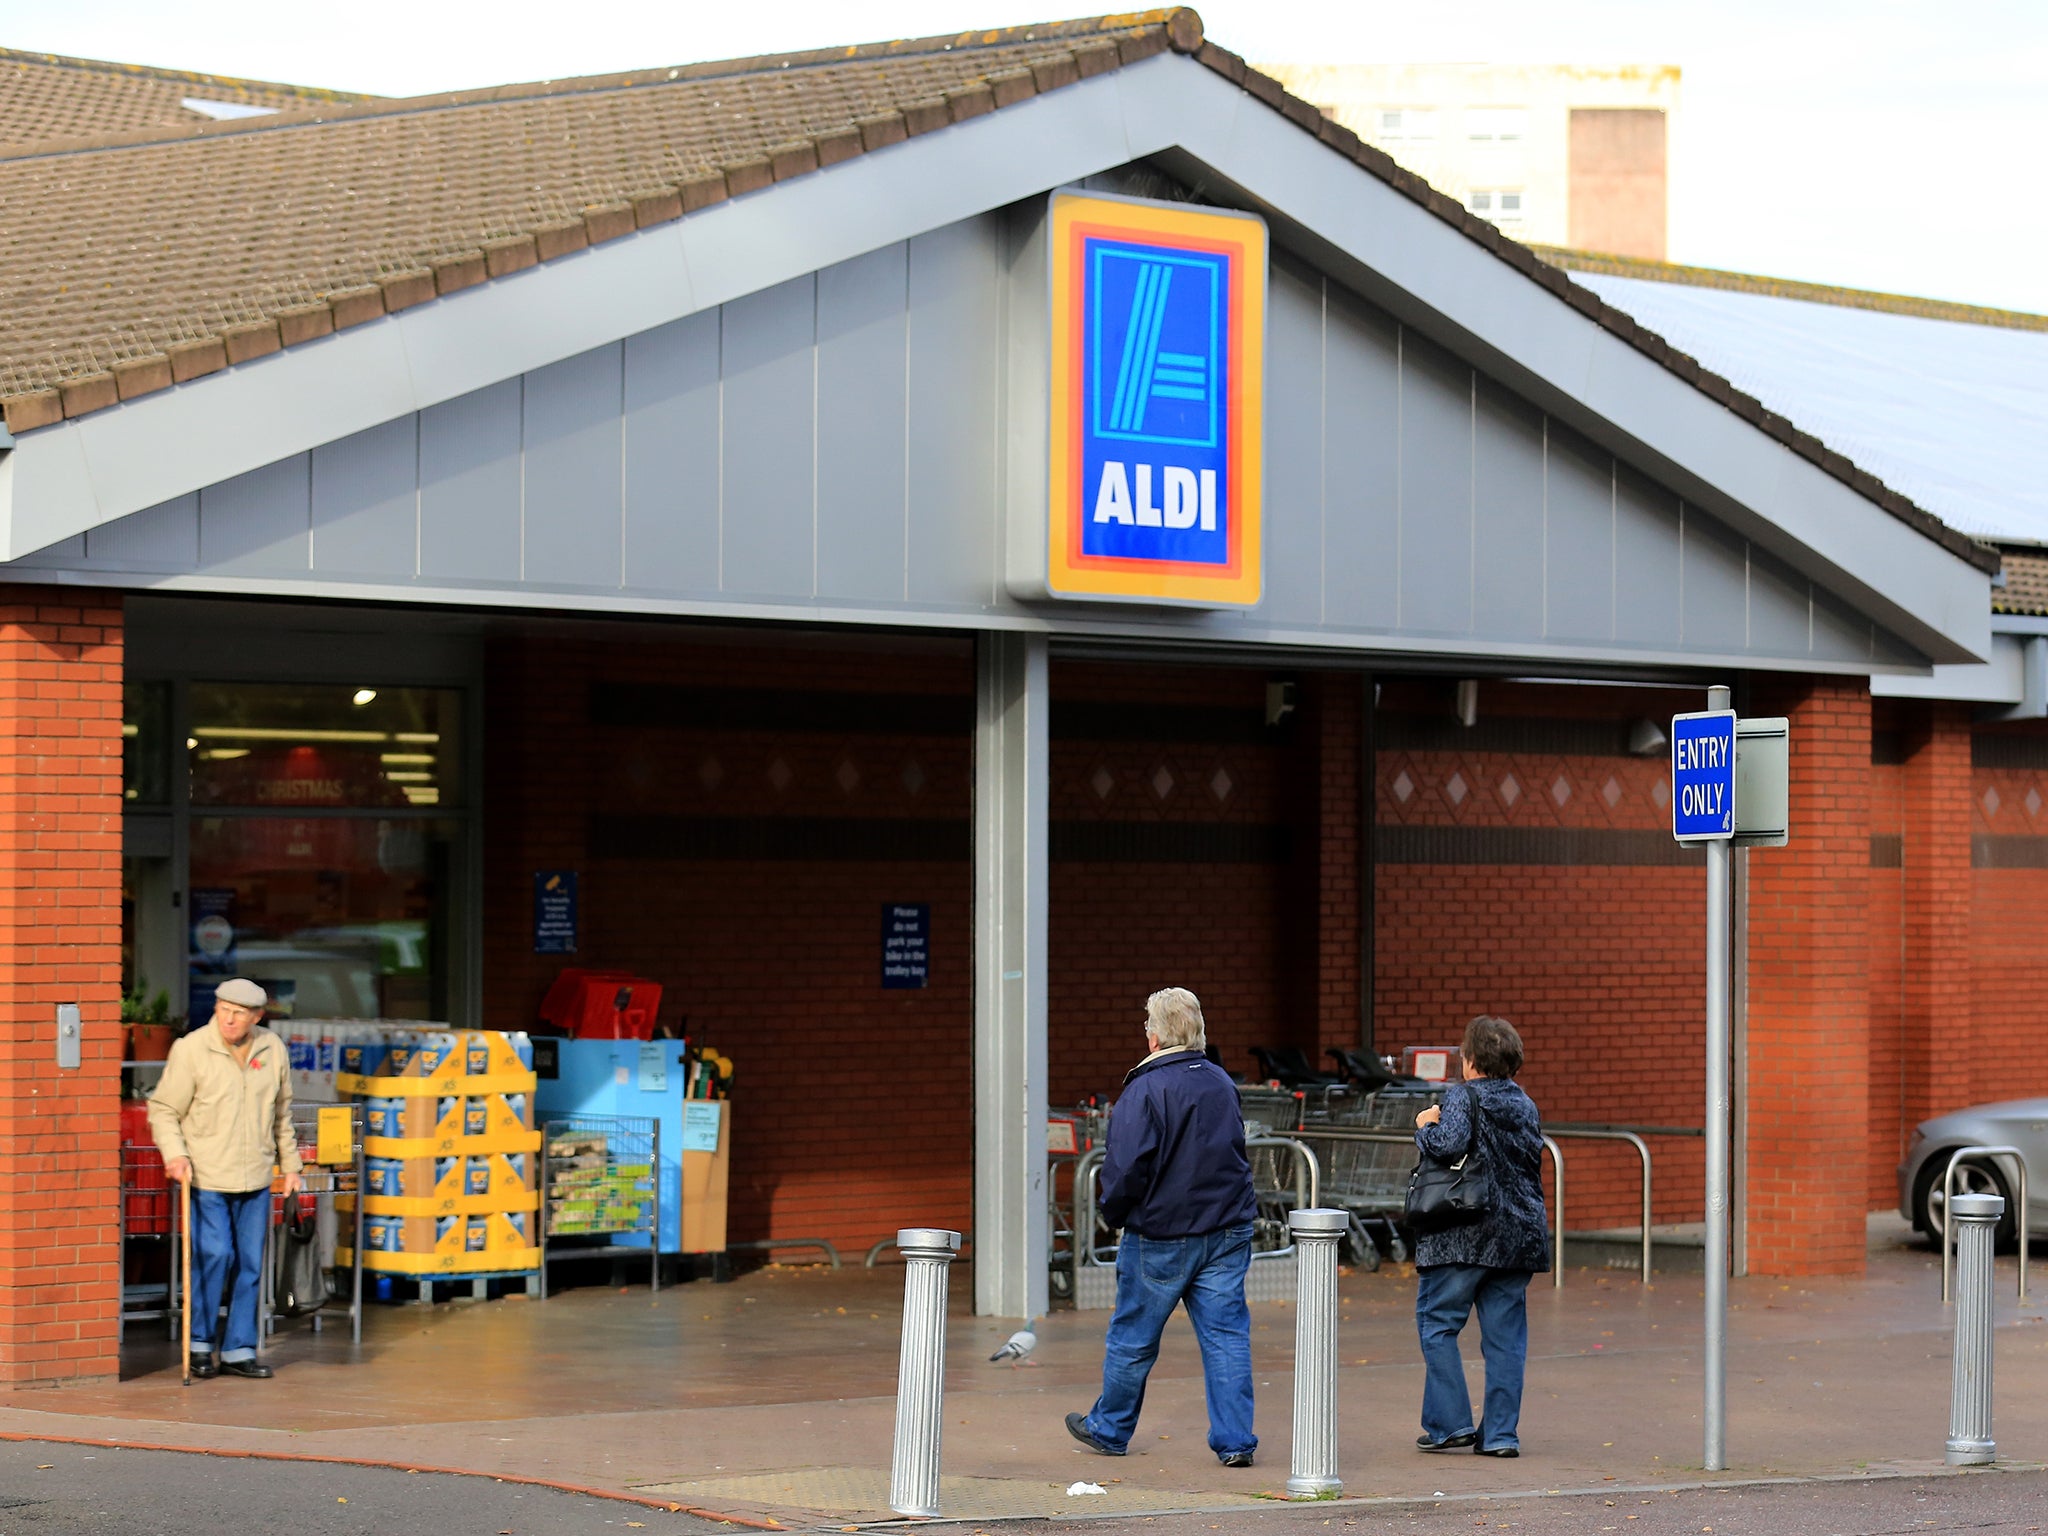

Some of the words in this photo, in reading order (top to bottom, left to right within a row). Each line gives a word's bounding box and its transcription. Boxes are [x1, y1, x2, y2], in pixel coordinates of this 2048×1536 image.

[1093, 460, 1217, 532] ALDI
[1677, 735, 1729, 771] ENTRY
[256, 779, 343, 799] CHRISTMAS
[1681, 782, 1724, 817] ONLY
[893, 906, 919, 917] Please
[893, 922, 903, 932] do
[905, 922, 919, 932] not
[886, 936, 905, 949] park
[906, 937, 924, 949] your
[885, 950, 903, 961] bike
[903, 950, 911, 961] in
[912, 950, 926, 961] the
